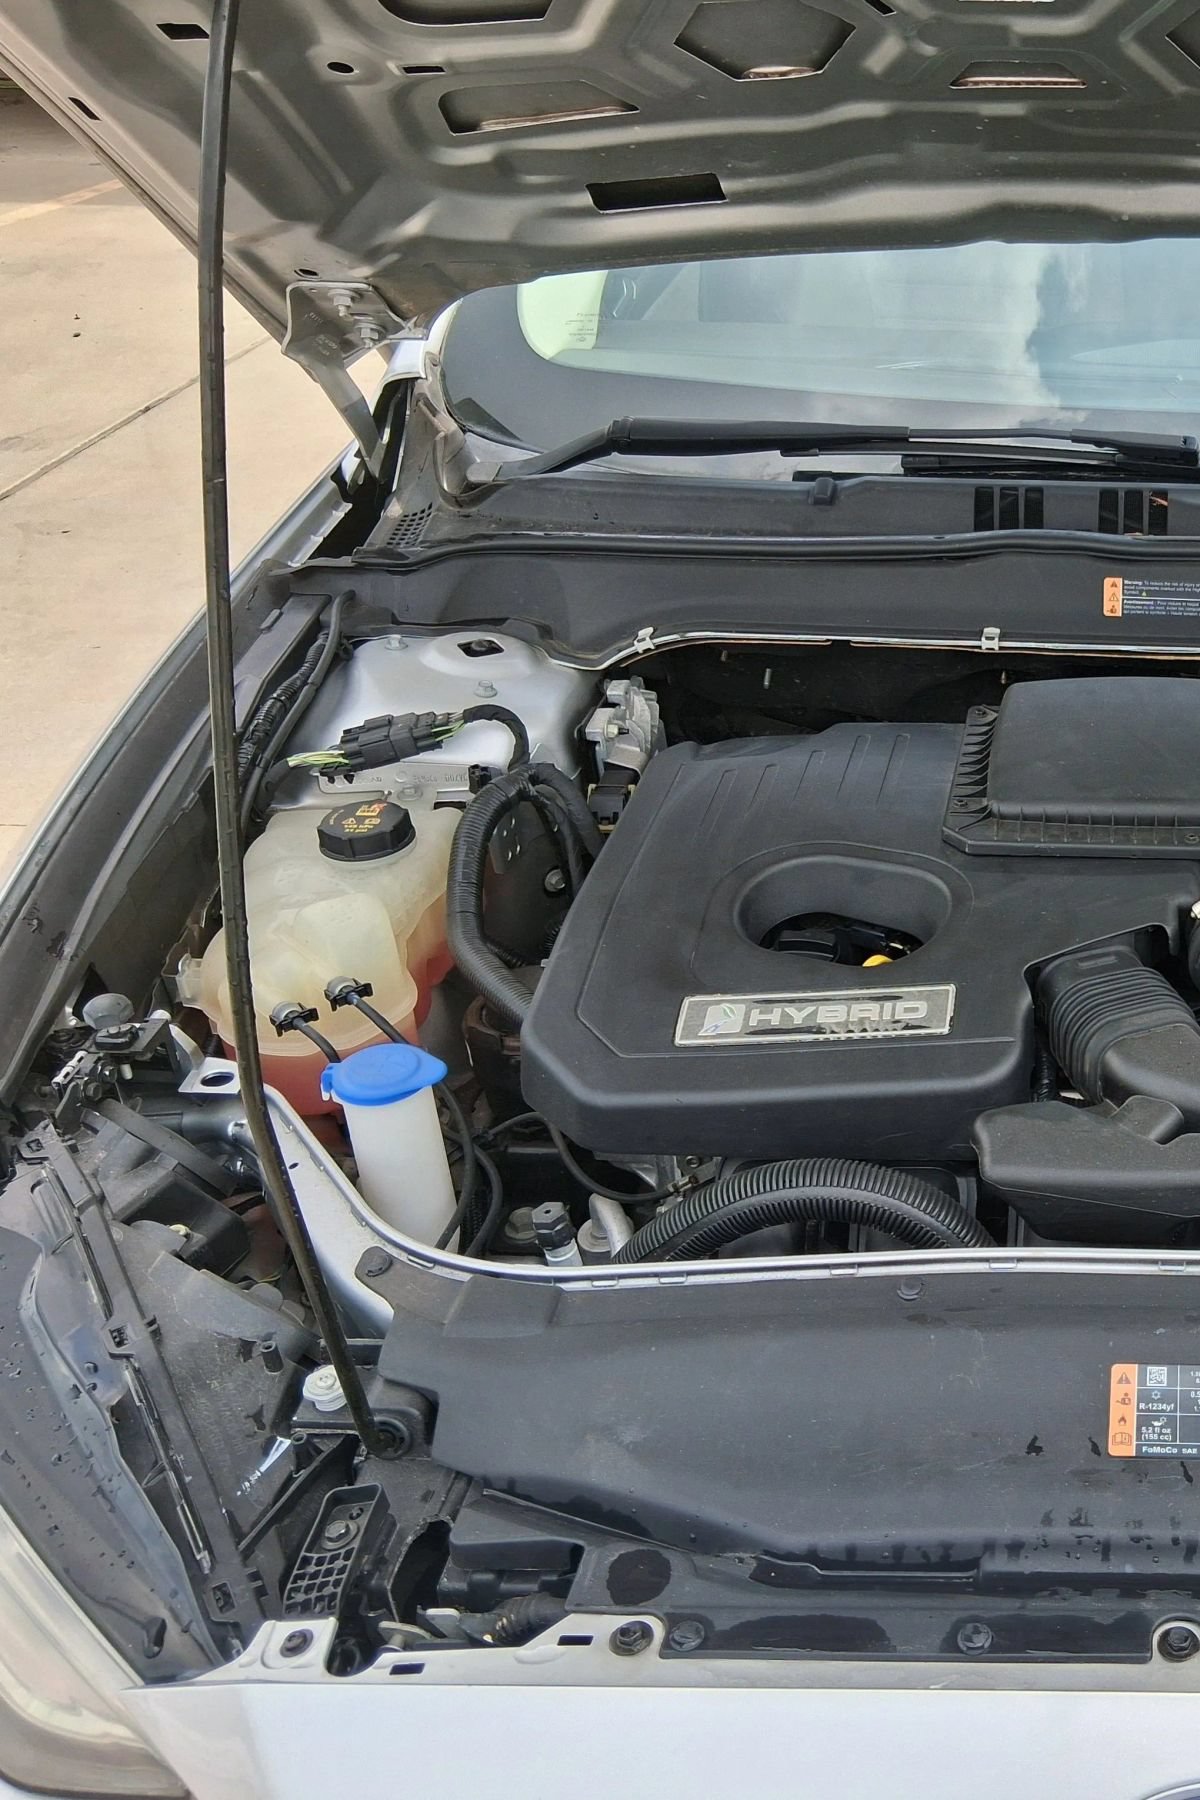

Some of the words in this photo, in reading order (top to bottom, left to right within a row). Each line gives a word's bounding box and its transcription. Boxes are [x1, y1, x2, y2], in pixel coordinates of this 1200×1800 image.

[749, 1000, 928, 1026] HYBRID
[1139, 1403, 1174, 1412] R-1234yf
[1142, 1446, 1178, 1454] FoMoCo
